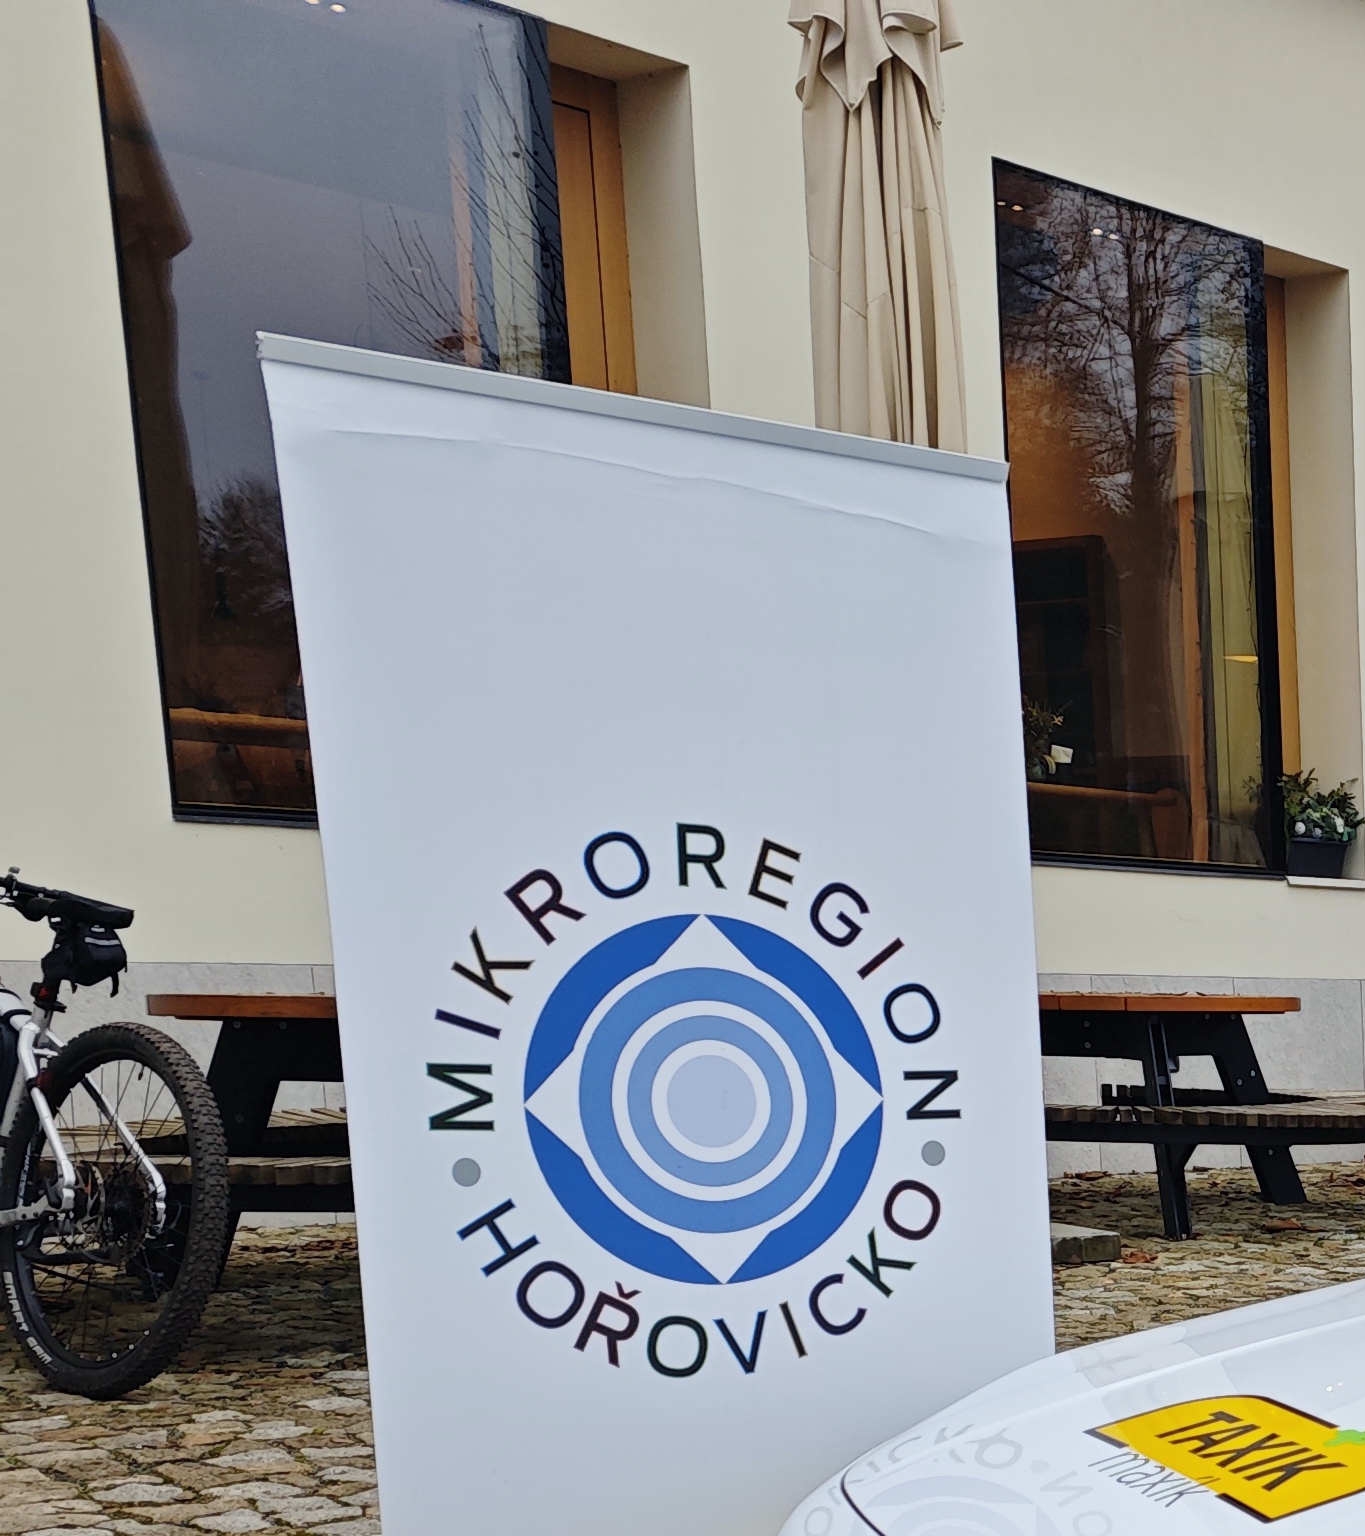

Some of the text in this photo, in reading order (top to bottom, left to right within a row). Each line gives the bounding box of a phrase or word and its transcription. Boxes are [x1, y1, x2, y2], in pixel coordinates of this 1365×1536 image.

[425, 821, 962, 1131] MIKROREGION
[456, 1180, 942, 1378] HOŘOVICKO
[1155, 1410, 1348, 1492] TAXIK
